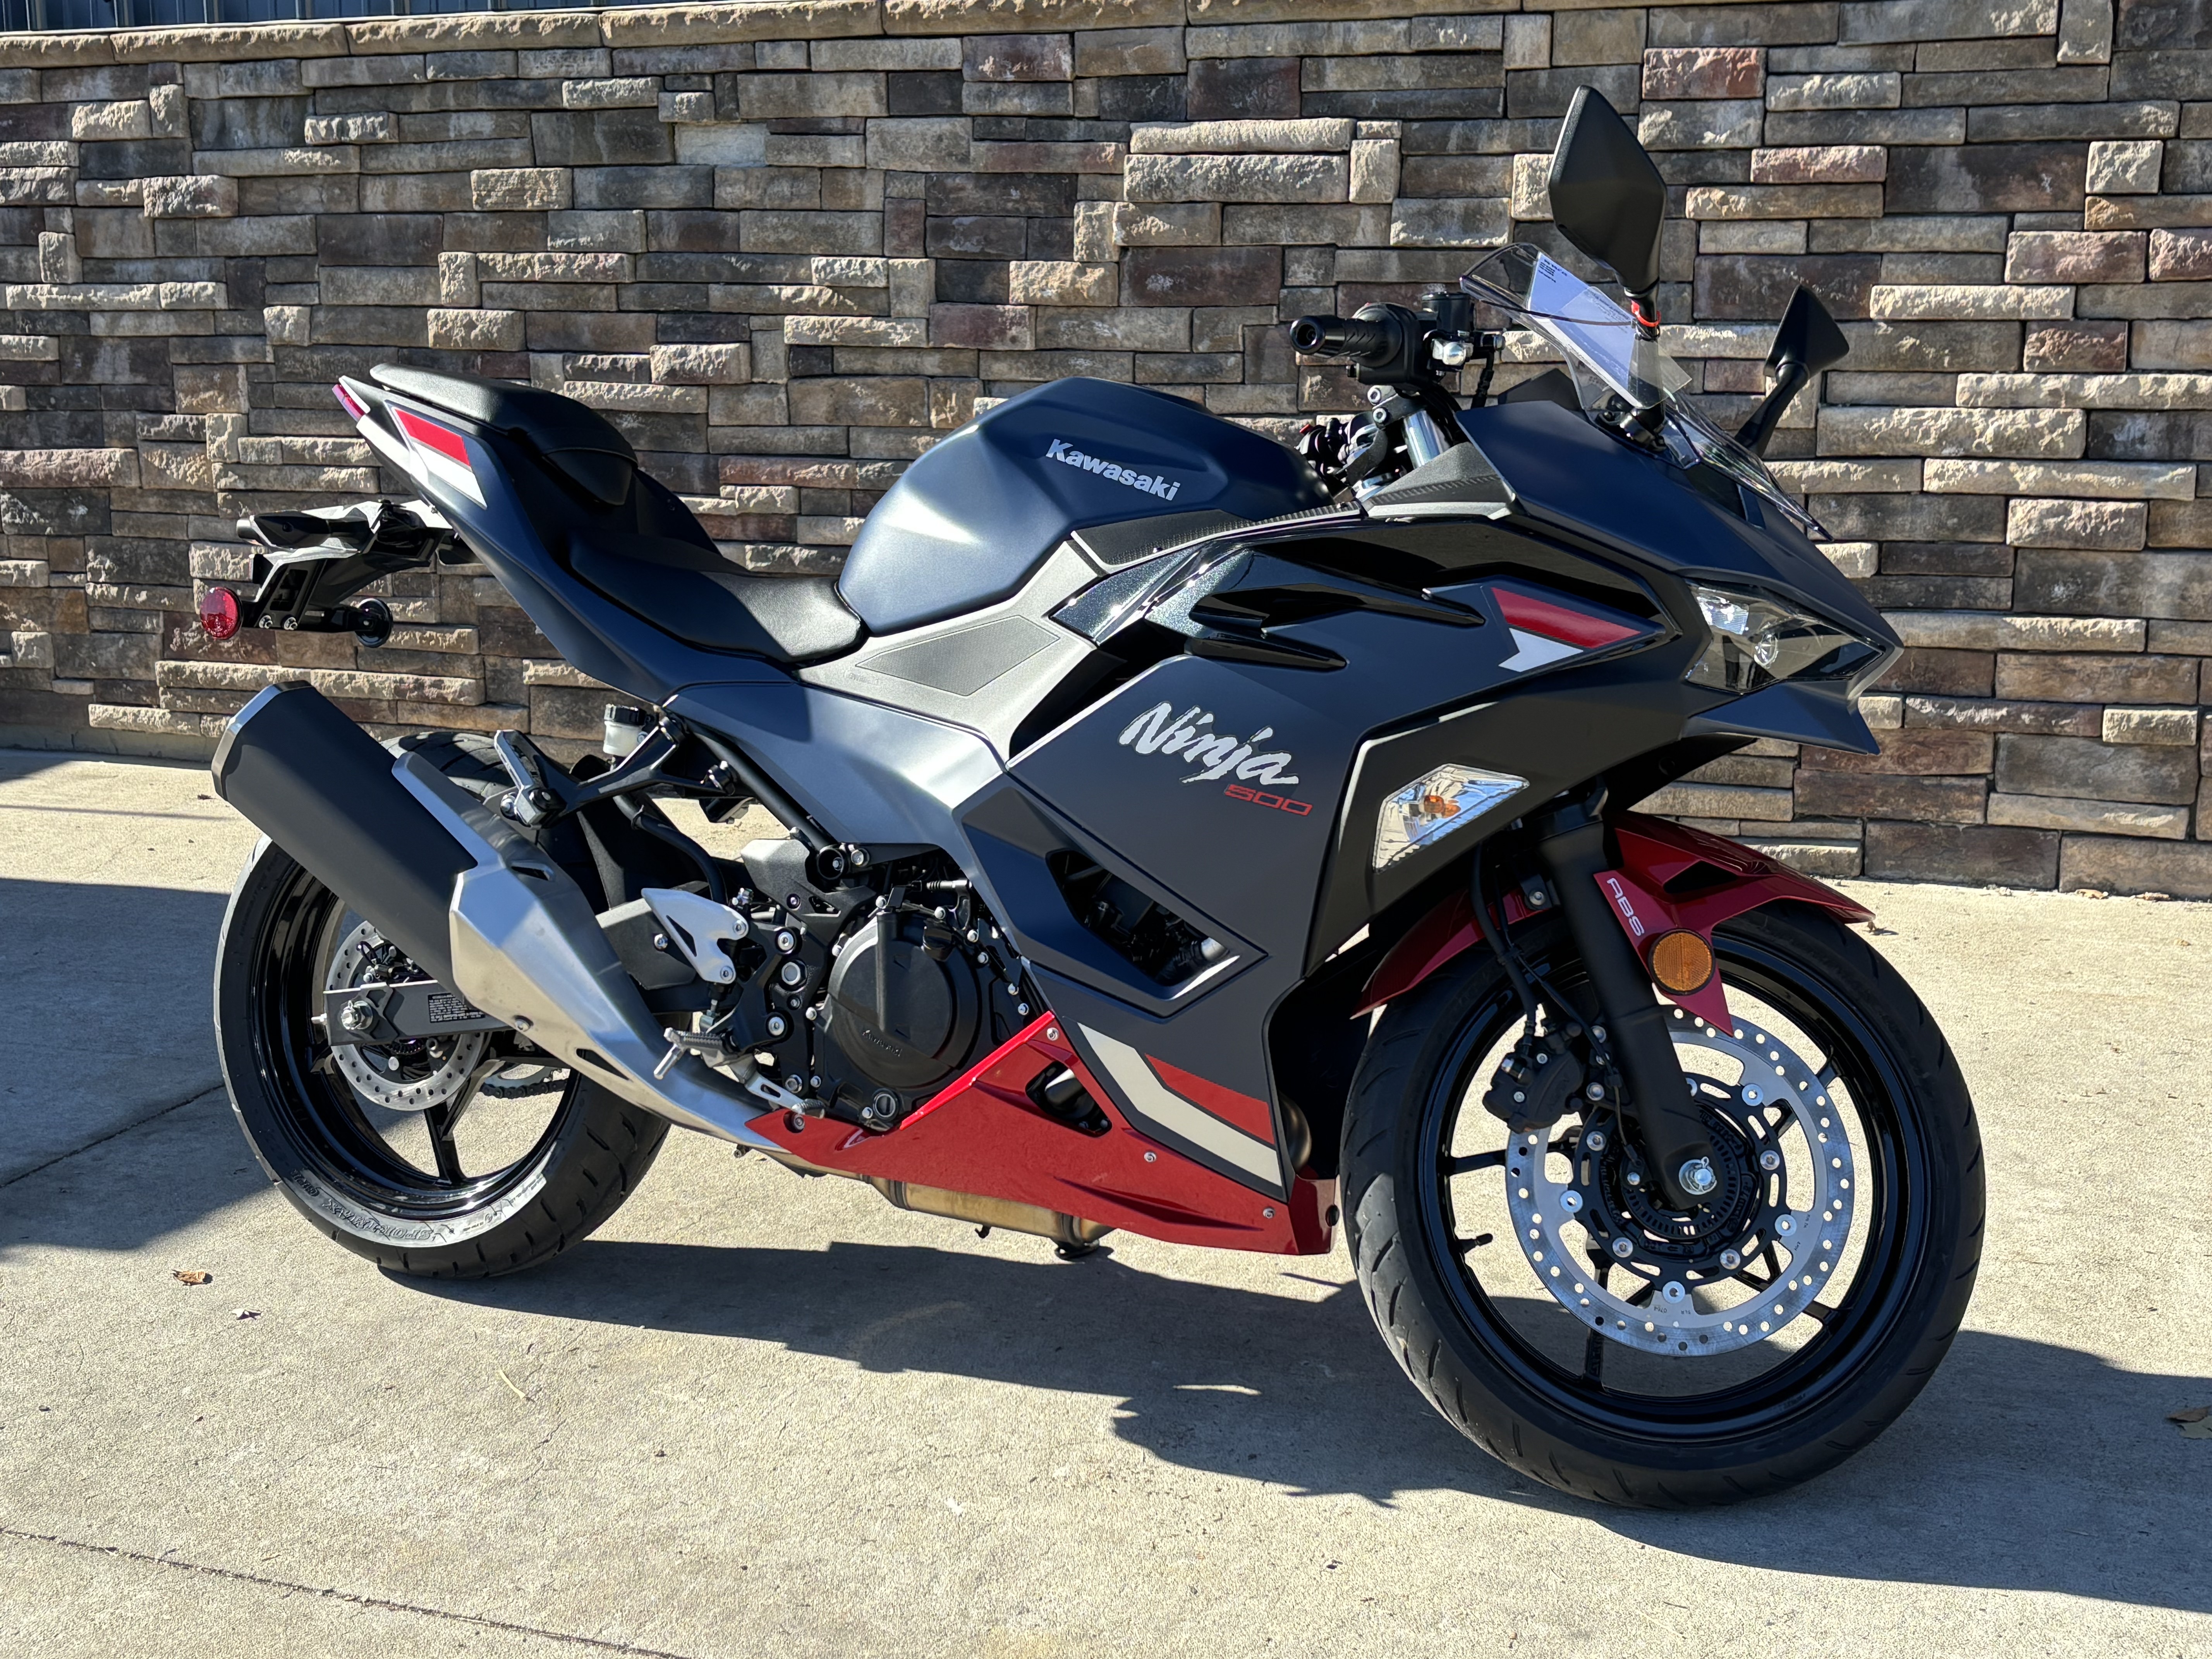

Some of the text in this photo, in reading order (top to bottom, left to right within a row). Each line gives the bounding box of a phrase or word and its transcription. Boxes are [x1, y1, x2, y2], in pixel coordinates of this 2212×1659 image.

[1046, 439, 1180, 501] Kawasaki
[1119, 702, 1299, 785] Ninja
[1225, 785, 1312, 816] 500
[1607, 878, 1644, 936] ABS
